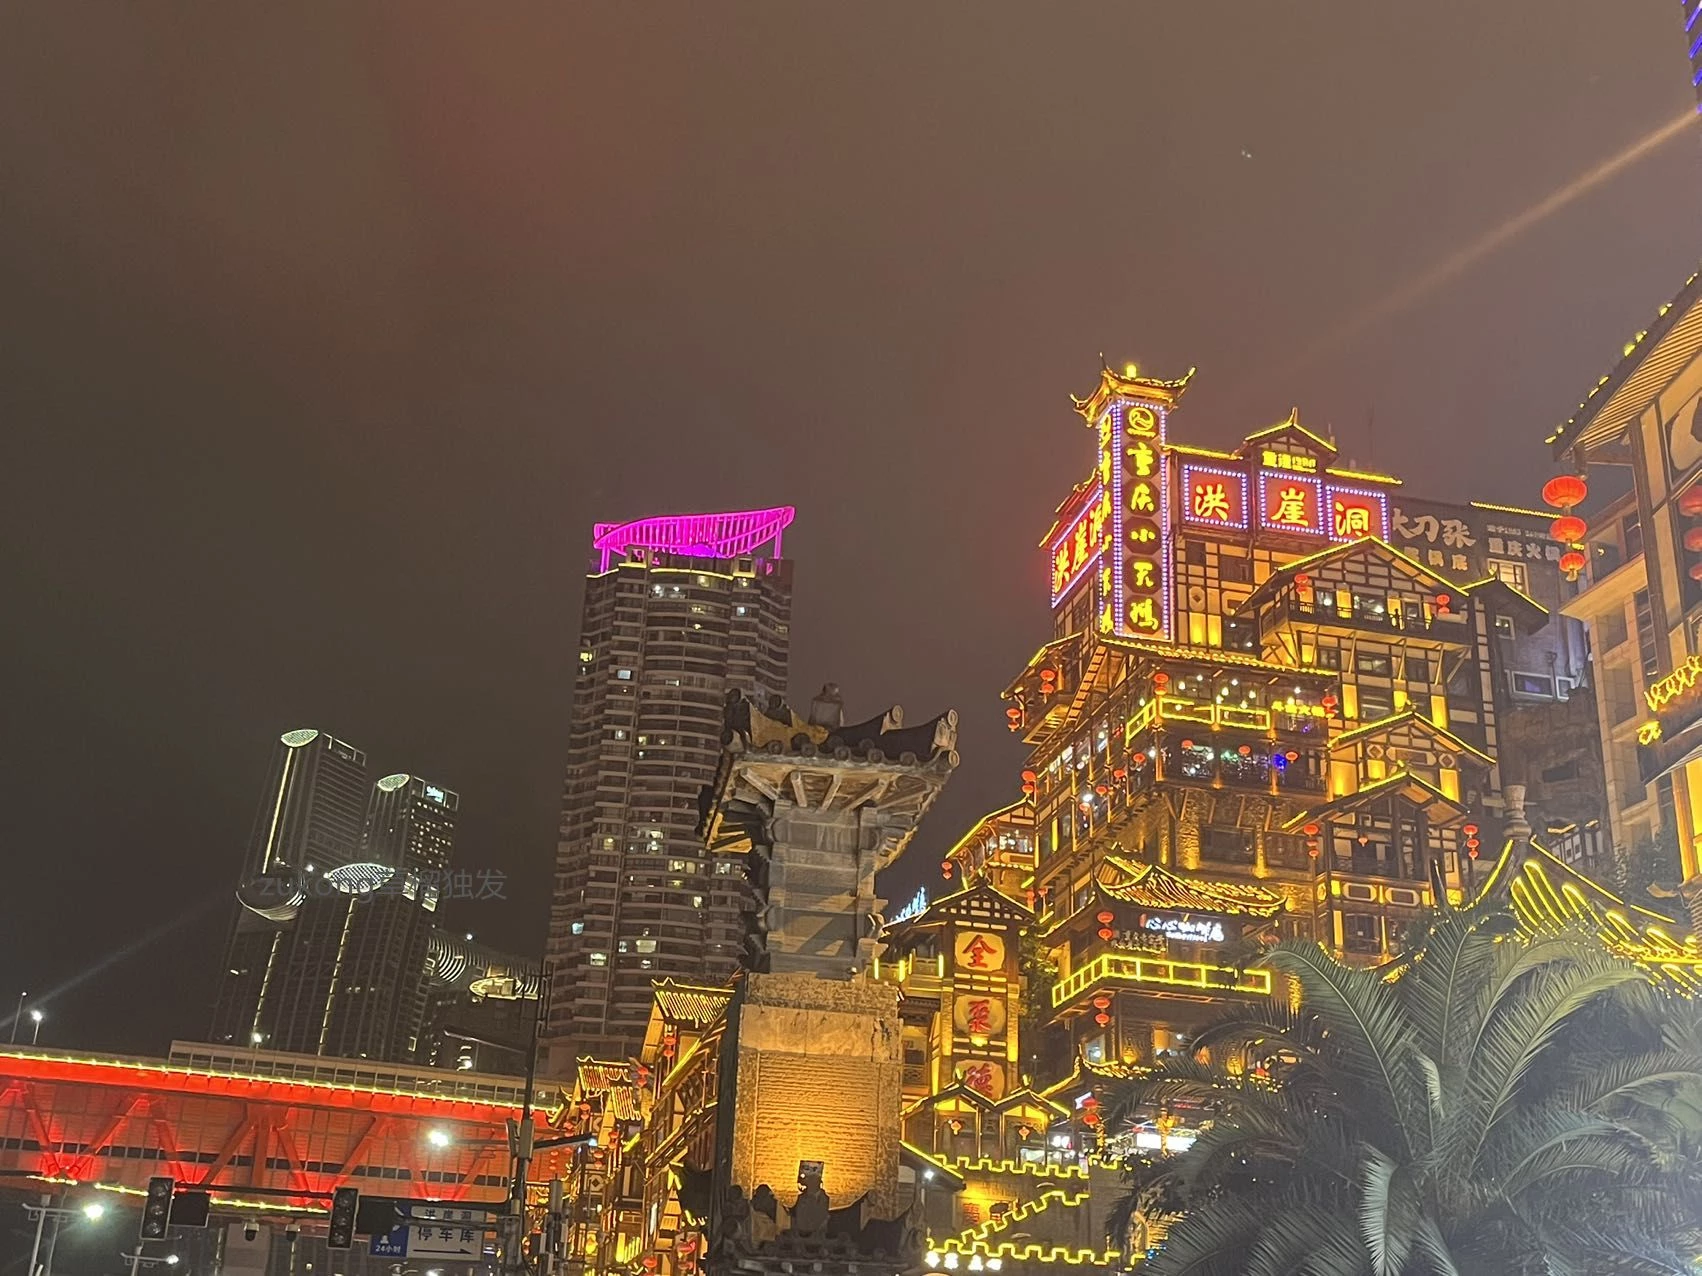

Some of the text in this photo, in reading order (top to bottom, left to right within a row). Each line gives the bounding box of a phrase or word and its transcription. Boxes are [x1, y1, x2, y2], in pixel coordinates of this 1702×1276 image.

[1194, 483, 1370, 537] 洪崖洞
[1488, 537, 1560, 562] 重庆火锅
[962, 934, 997, 1097] 全聚德
[418, 1226, 476, 1243] 停车库
[375, 1245, 401, 1254] 24小时
